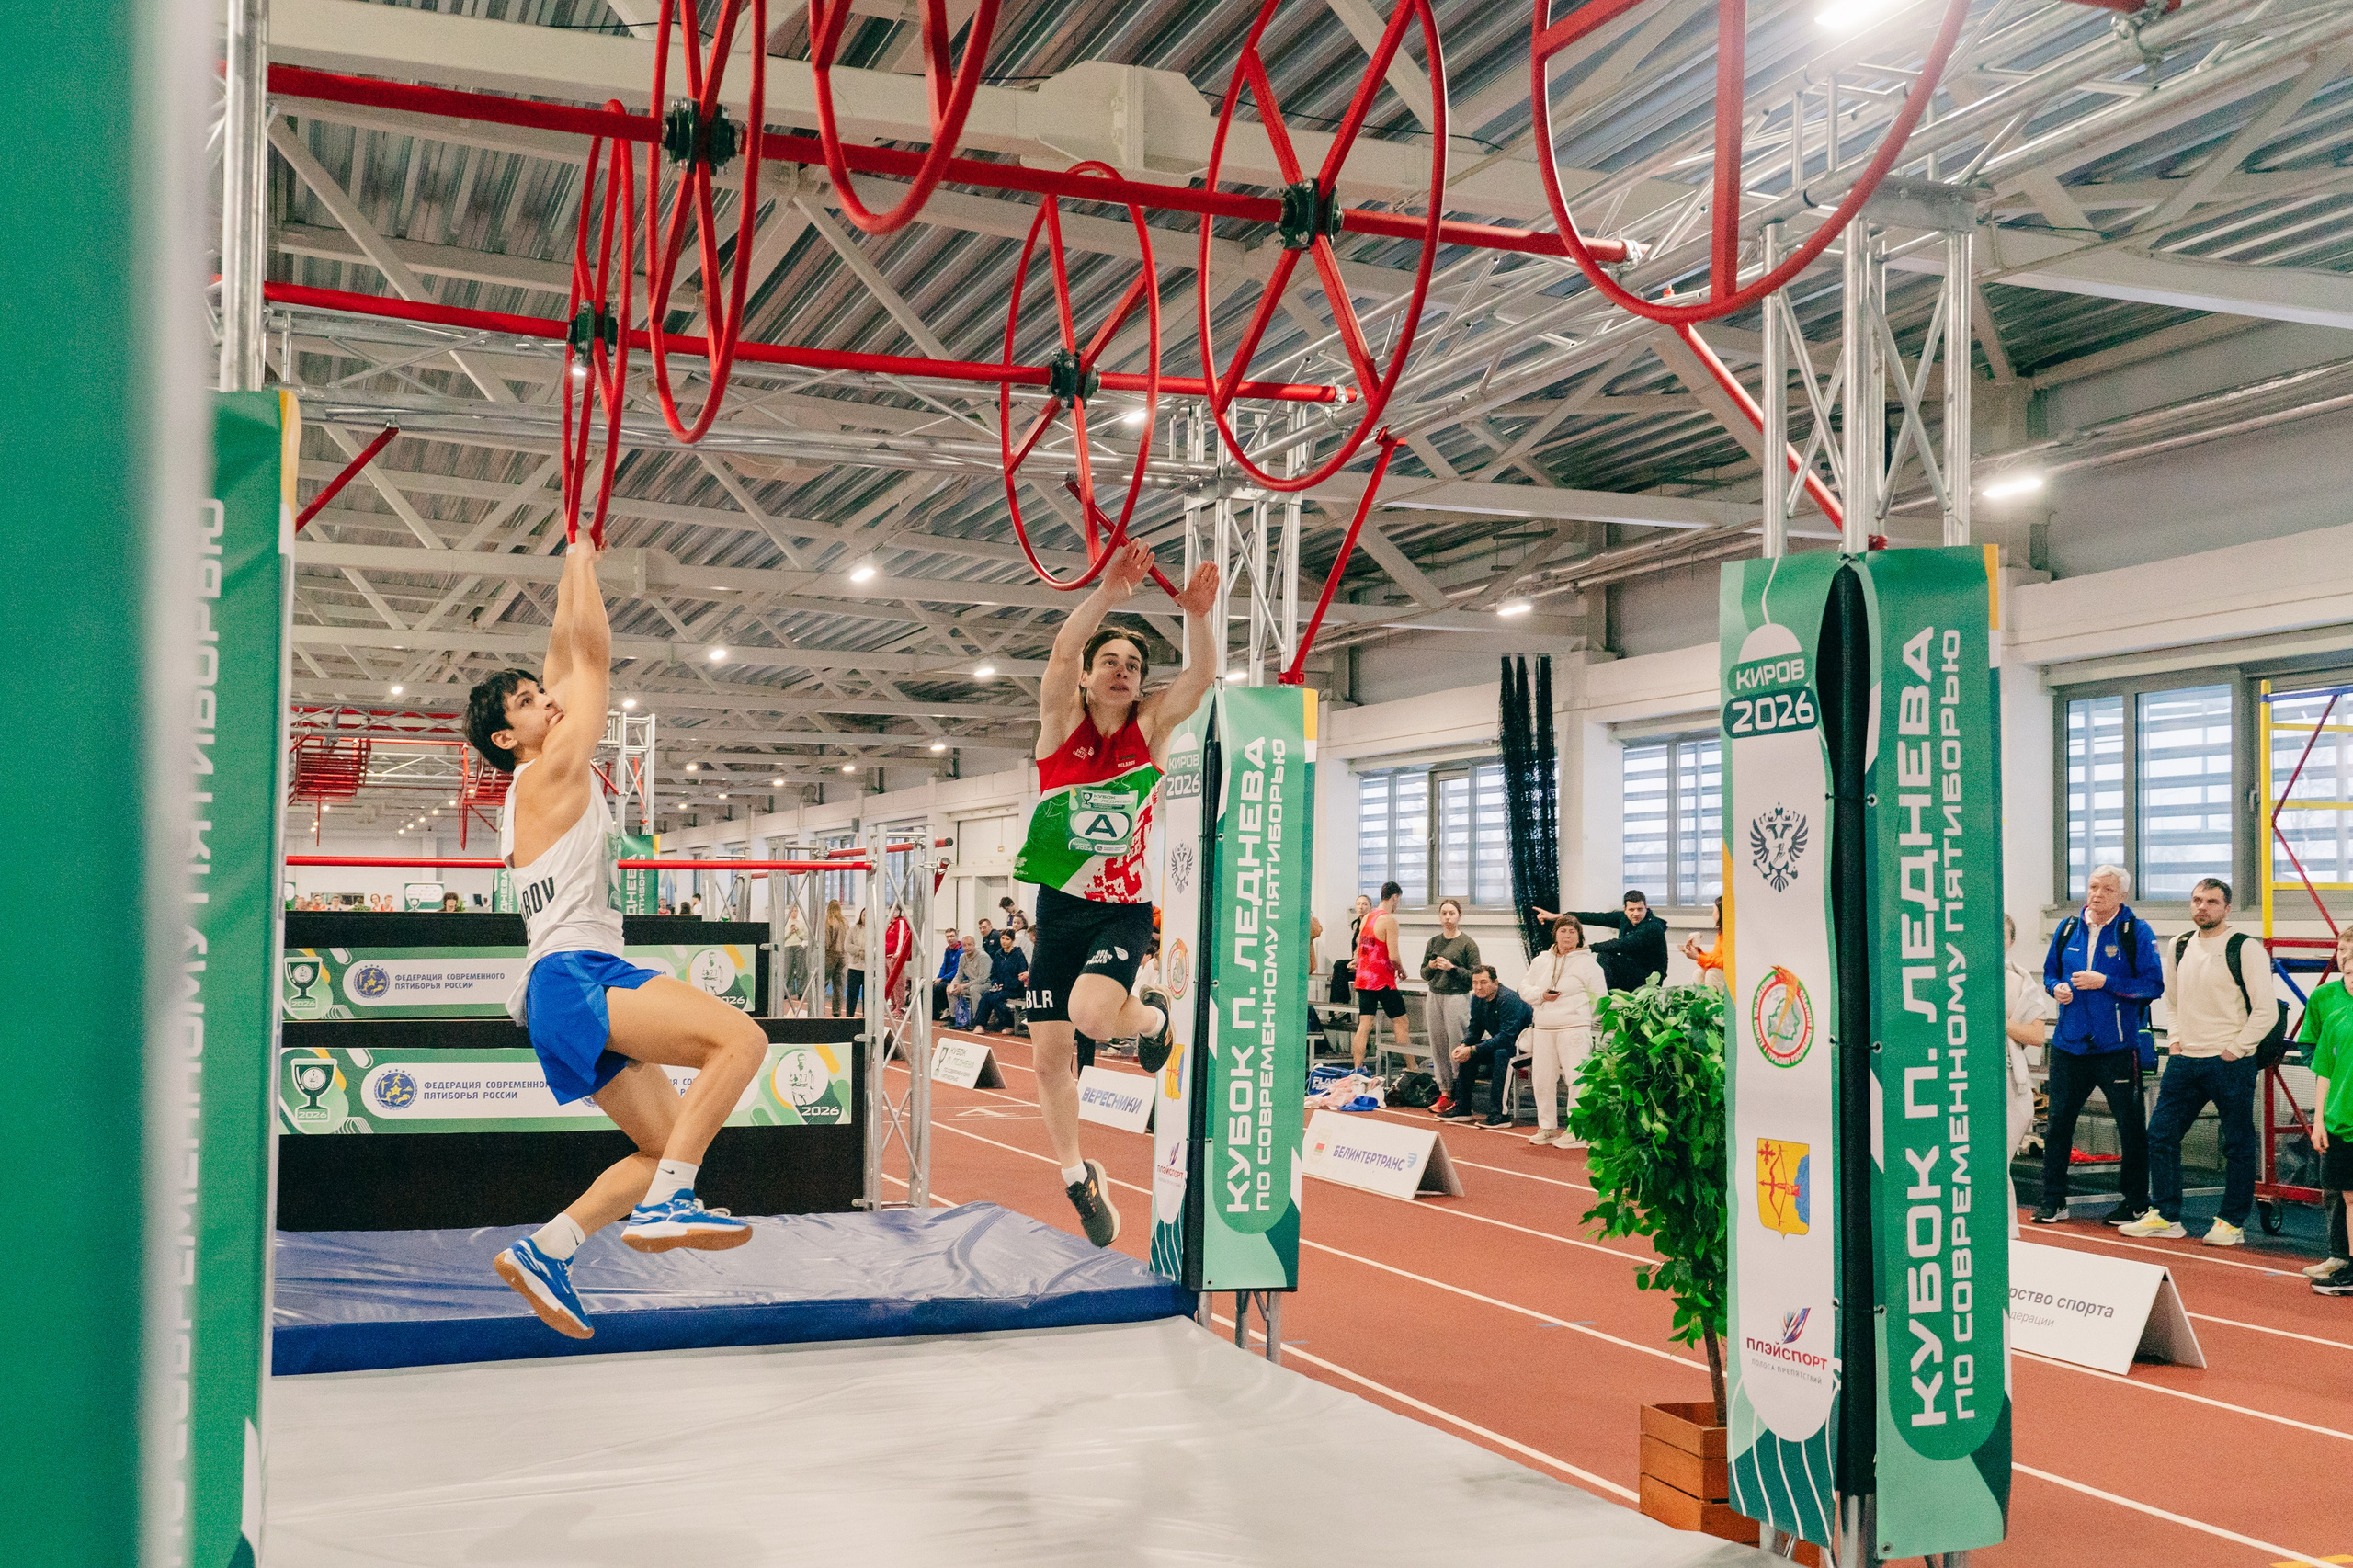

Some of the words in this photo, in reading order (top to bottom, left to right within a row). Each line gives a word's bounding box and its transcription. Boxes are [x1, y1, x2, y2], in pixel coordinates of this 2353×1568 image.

[1736, 658, 1805, 691] КИРОВ
[1732, 691, 1815, 733] 2026
[1168, 754, 1199, 771] КИРОВ
[1166, 773, 1201, 797] 2026
[1940, 630, 1964, 932] ПЯТИБОРЬЮ
[1266, 738, 1286, 919] ПЯТИБОРЬЮ
[1897, 626, 1940, 1023] ЛЕДНЕВА
[1234, 736, 1266, 973] ЛЕДНЕВА
[520, 876, 555, 926] ROV
[394, 973, 443, 983] ФЕДЕРАЦИЯ
[446, 972, 506, 981] СОВРЕМЕННОГО
[394, 982, 441, 990] ПЯТИБОРЬЯ
[1026, 989, 1054, 1010] BLR
[1232, 987, 1256, 1028] П.
[1257, 926, 1279, 1165] СОВРЕМЕННОМУ
[423, 1081, 482, 1090] ФЕДЕРАЦИЯ
[423, 1091, 479, 1100] ПЯТИБОРЬЯ
[483, 1091, 517, 1099] РОССИИ
[1904, 1048, 1938, 1119] П.
[801, 1106, 840, 1116] 2026
[1081, 1087, 1143, 1114] ВЕРЕСНИКИ
[1227, 1045, 1255, 1212] КУБОК
[1945, 942, 1973, 1342] СОВРЕМЕННОМУ
[1333, 1145, 1405, 1171] БЕЛИНТЕРТРАНС
[1256, 1171, 1271, 1210] ПО
[1905, 1145, 1947, 1426] КУБОК
[2009, 1287, 2053, 1306] рство
[2057, 1297, 2115, 1319] спорта
[2009, 1311, 2055, 1328] дерации
[1746, 1337, 1827, 1370] ПЛЭЙСПОРТ
[1751, 1358, 1776, 1371] ПОЛОСА
[1777, 1366, 1822, 1384] ПРЕПЯТСТВИЙ
[1954, 1354, 1975, 1419] ПО
